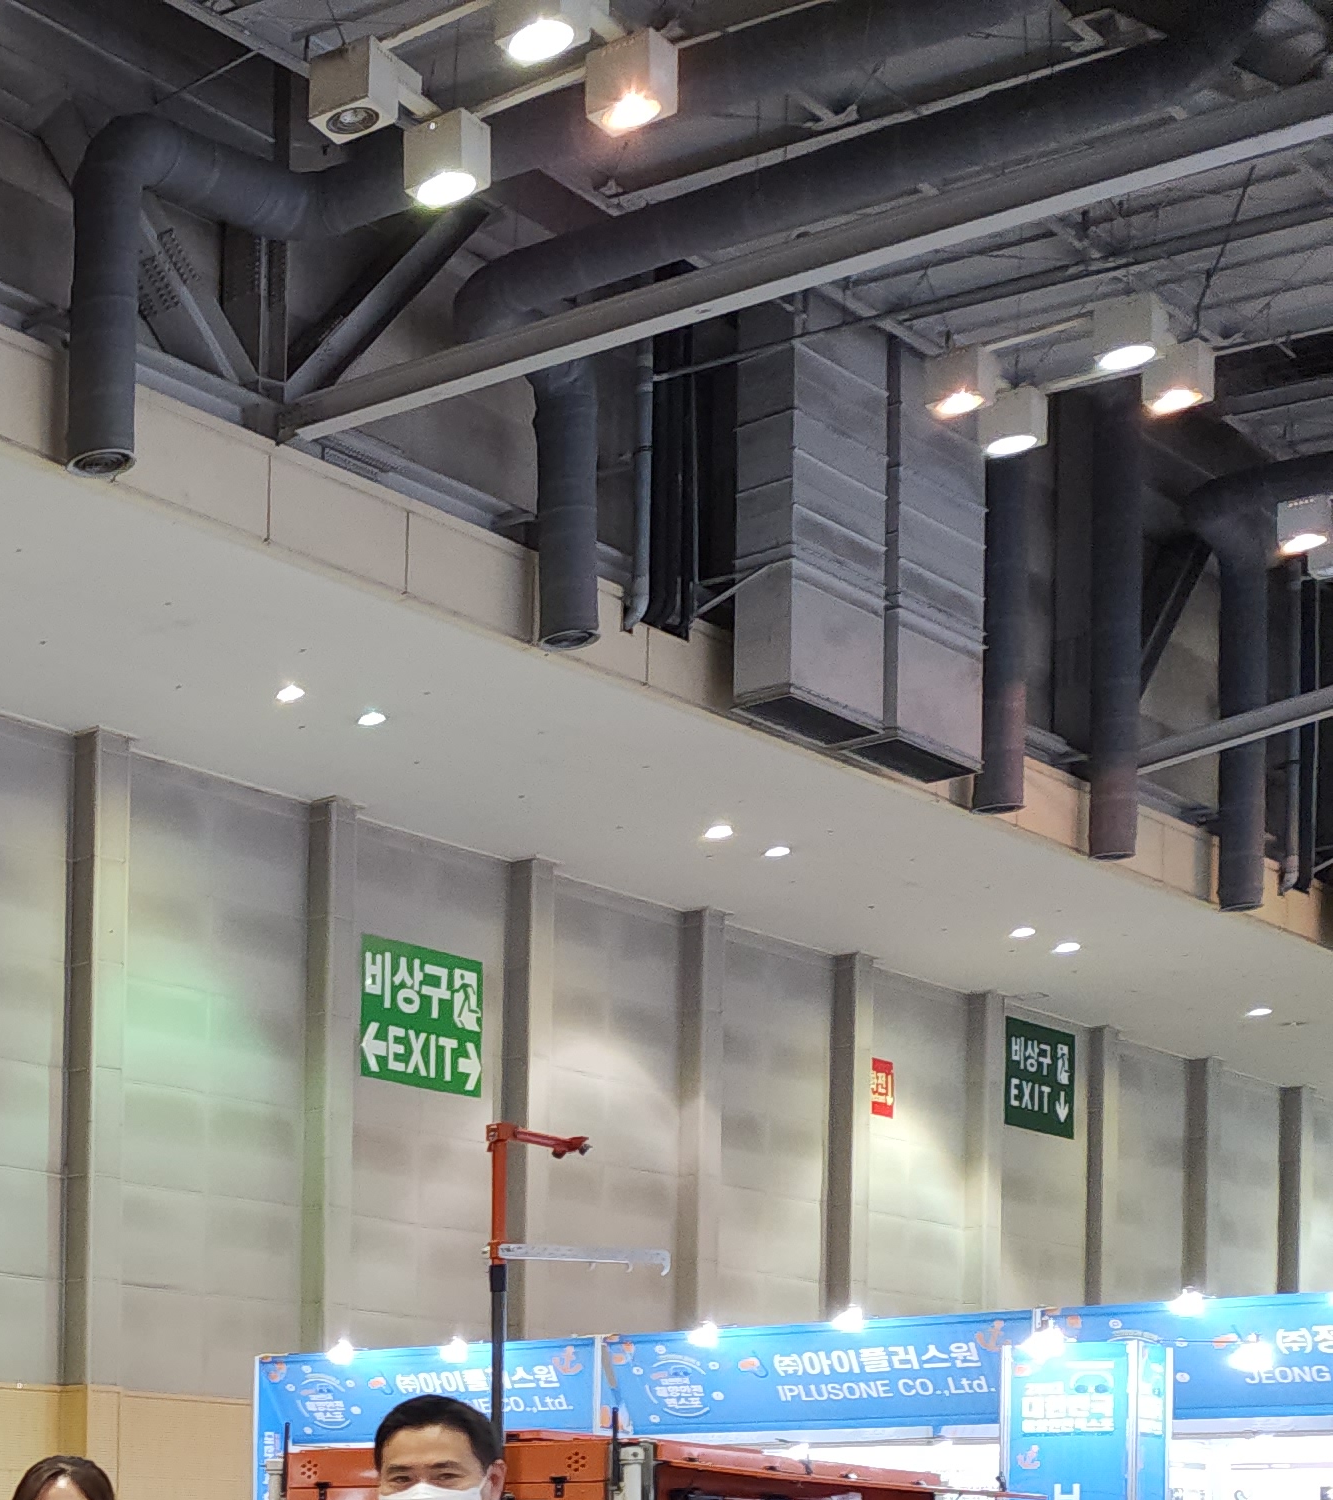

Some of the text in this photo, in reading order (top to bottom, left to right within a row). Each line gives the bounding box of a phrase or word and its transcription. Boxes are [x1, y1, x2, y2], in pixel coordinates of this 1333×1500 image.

[365, 951, 452, 1019] 비상구
[387, 1025, 459, 1082] EXIT
[1010, 1036, 1053, 1076] 비상구
[1010, 1077, 1052, 1114] EXIT
[776, 1379, 894, 1402] IPLUSONE
